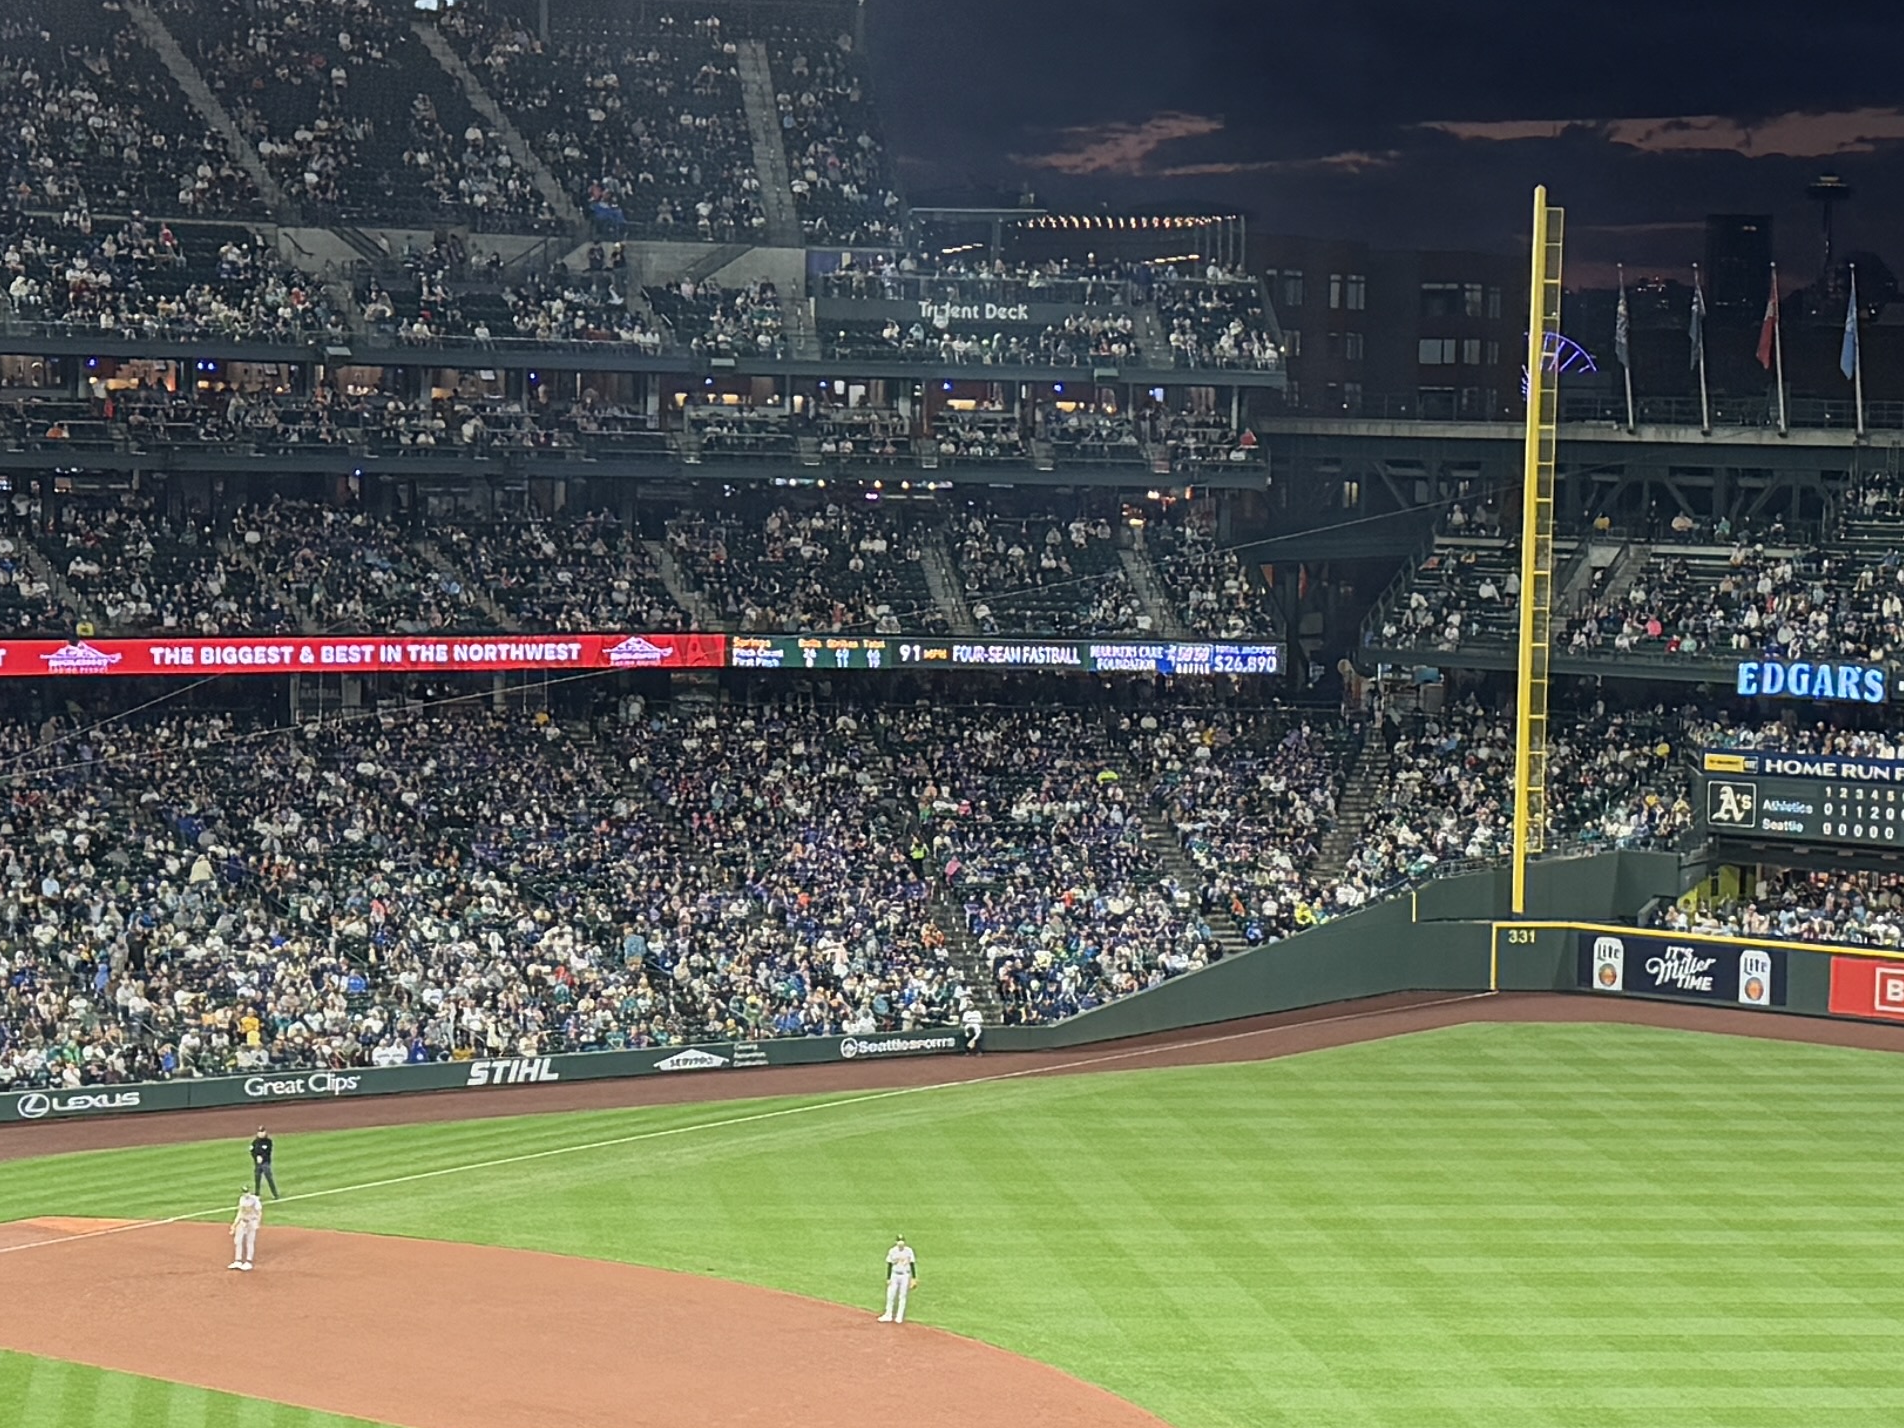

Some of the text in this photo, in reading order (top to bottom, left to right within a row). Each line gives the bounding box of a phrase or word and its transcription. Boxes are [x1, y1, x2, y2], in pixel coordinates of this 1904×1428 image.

[985, 301, 1029, 321] Deck
[150, 642, 581, 666] THE BIGGEST & BEST IN THE NORTHWEST
[899, 645, 921, 662] 91
[1023, 645, 1081, 664] FASTBALL
[1737, 661, 1885, 703] EDGAR'S
[1765, 759, 1837, 778] HOME
[1841, 762, 1891, 781] RUN
[1508, 929, 1536, 944] 331
[1665, 945, 1693, 960] IT'S
[1646, 957, 1716, 986] Miller
[1677, 976, 1713, 992] TIME
[466, 1057, 560, 1086] STIHL
[245, 1073, 359, 1097] Great Clips
[52, 1091, 141, 1111] LEXUS
